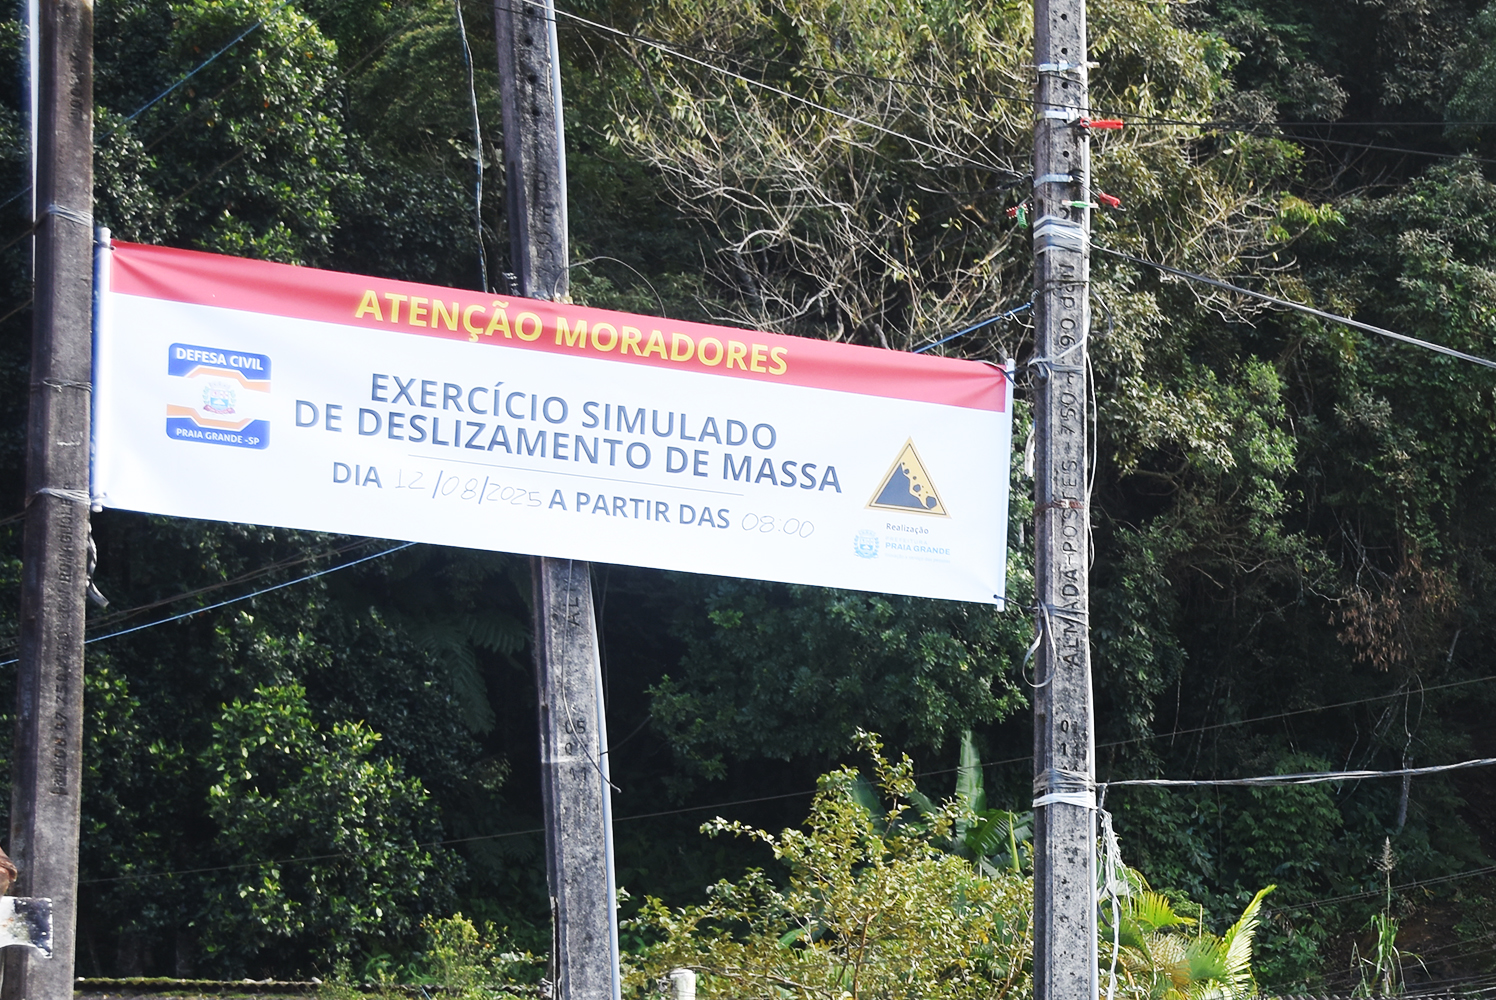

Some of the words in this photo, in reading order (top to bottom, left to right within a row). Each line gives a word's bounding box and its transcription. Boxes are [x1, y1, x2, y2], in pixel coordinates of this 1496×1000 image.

[354, 289, 543, 343] ATENÇÃO
[554, 317, 788, 375] MORADORES
[175, 347, 227, 366] DEFESA
[229, 355, 264, 371] CIVIL
[176, 428, 204, 440] PRAIA
[205, 431, 243, 444] GRANDE
[371, 373, 569, 424] EXERCÍCIO
[581, 401, 777, 450] SIMULADO
[295, 399, 343, 432] DE
[358, 407, 652, 469] DESLIZAMENTO
[665, 446, 710, 477] DE
[722, 453, 843, 493] MASSA
[333, 461, 383, 488] DIA
[548, 489, 567, 511] A
[576, 491, 671, 523] PARTIR
[679, 504, 731, 529] DAS
[741, 512, 815, 538] 08:00
[885, 542, 912, 552] PRAIA
[913, 546, 950, 555] GRANDE
[886, 522, 929, 535] Realização
